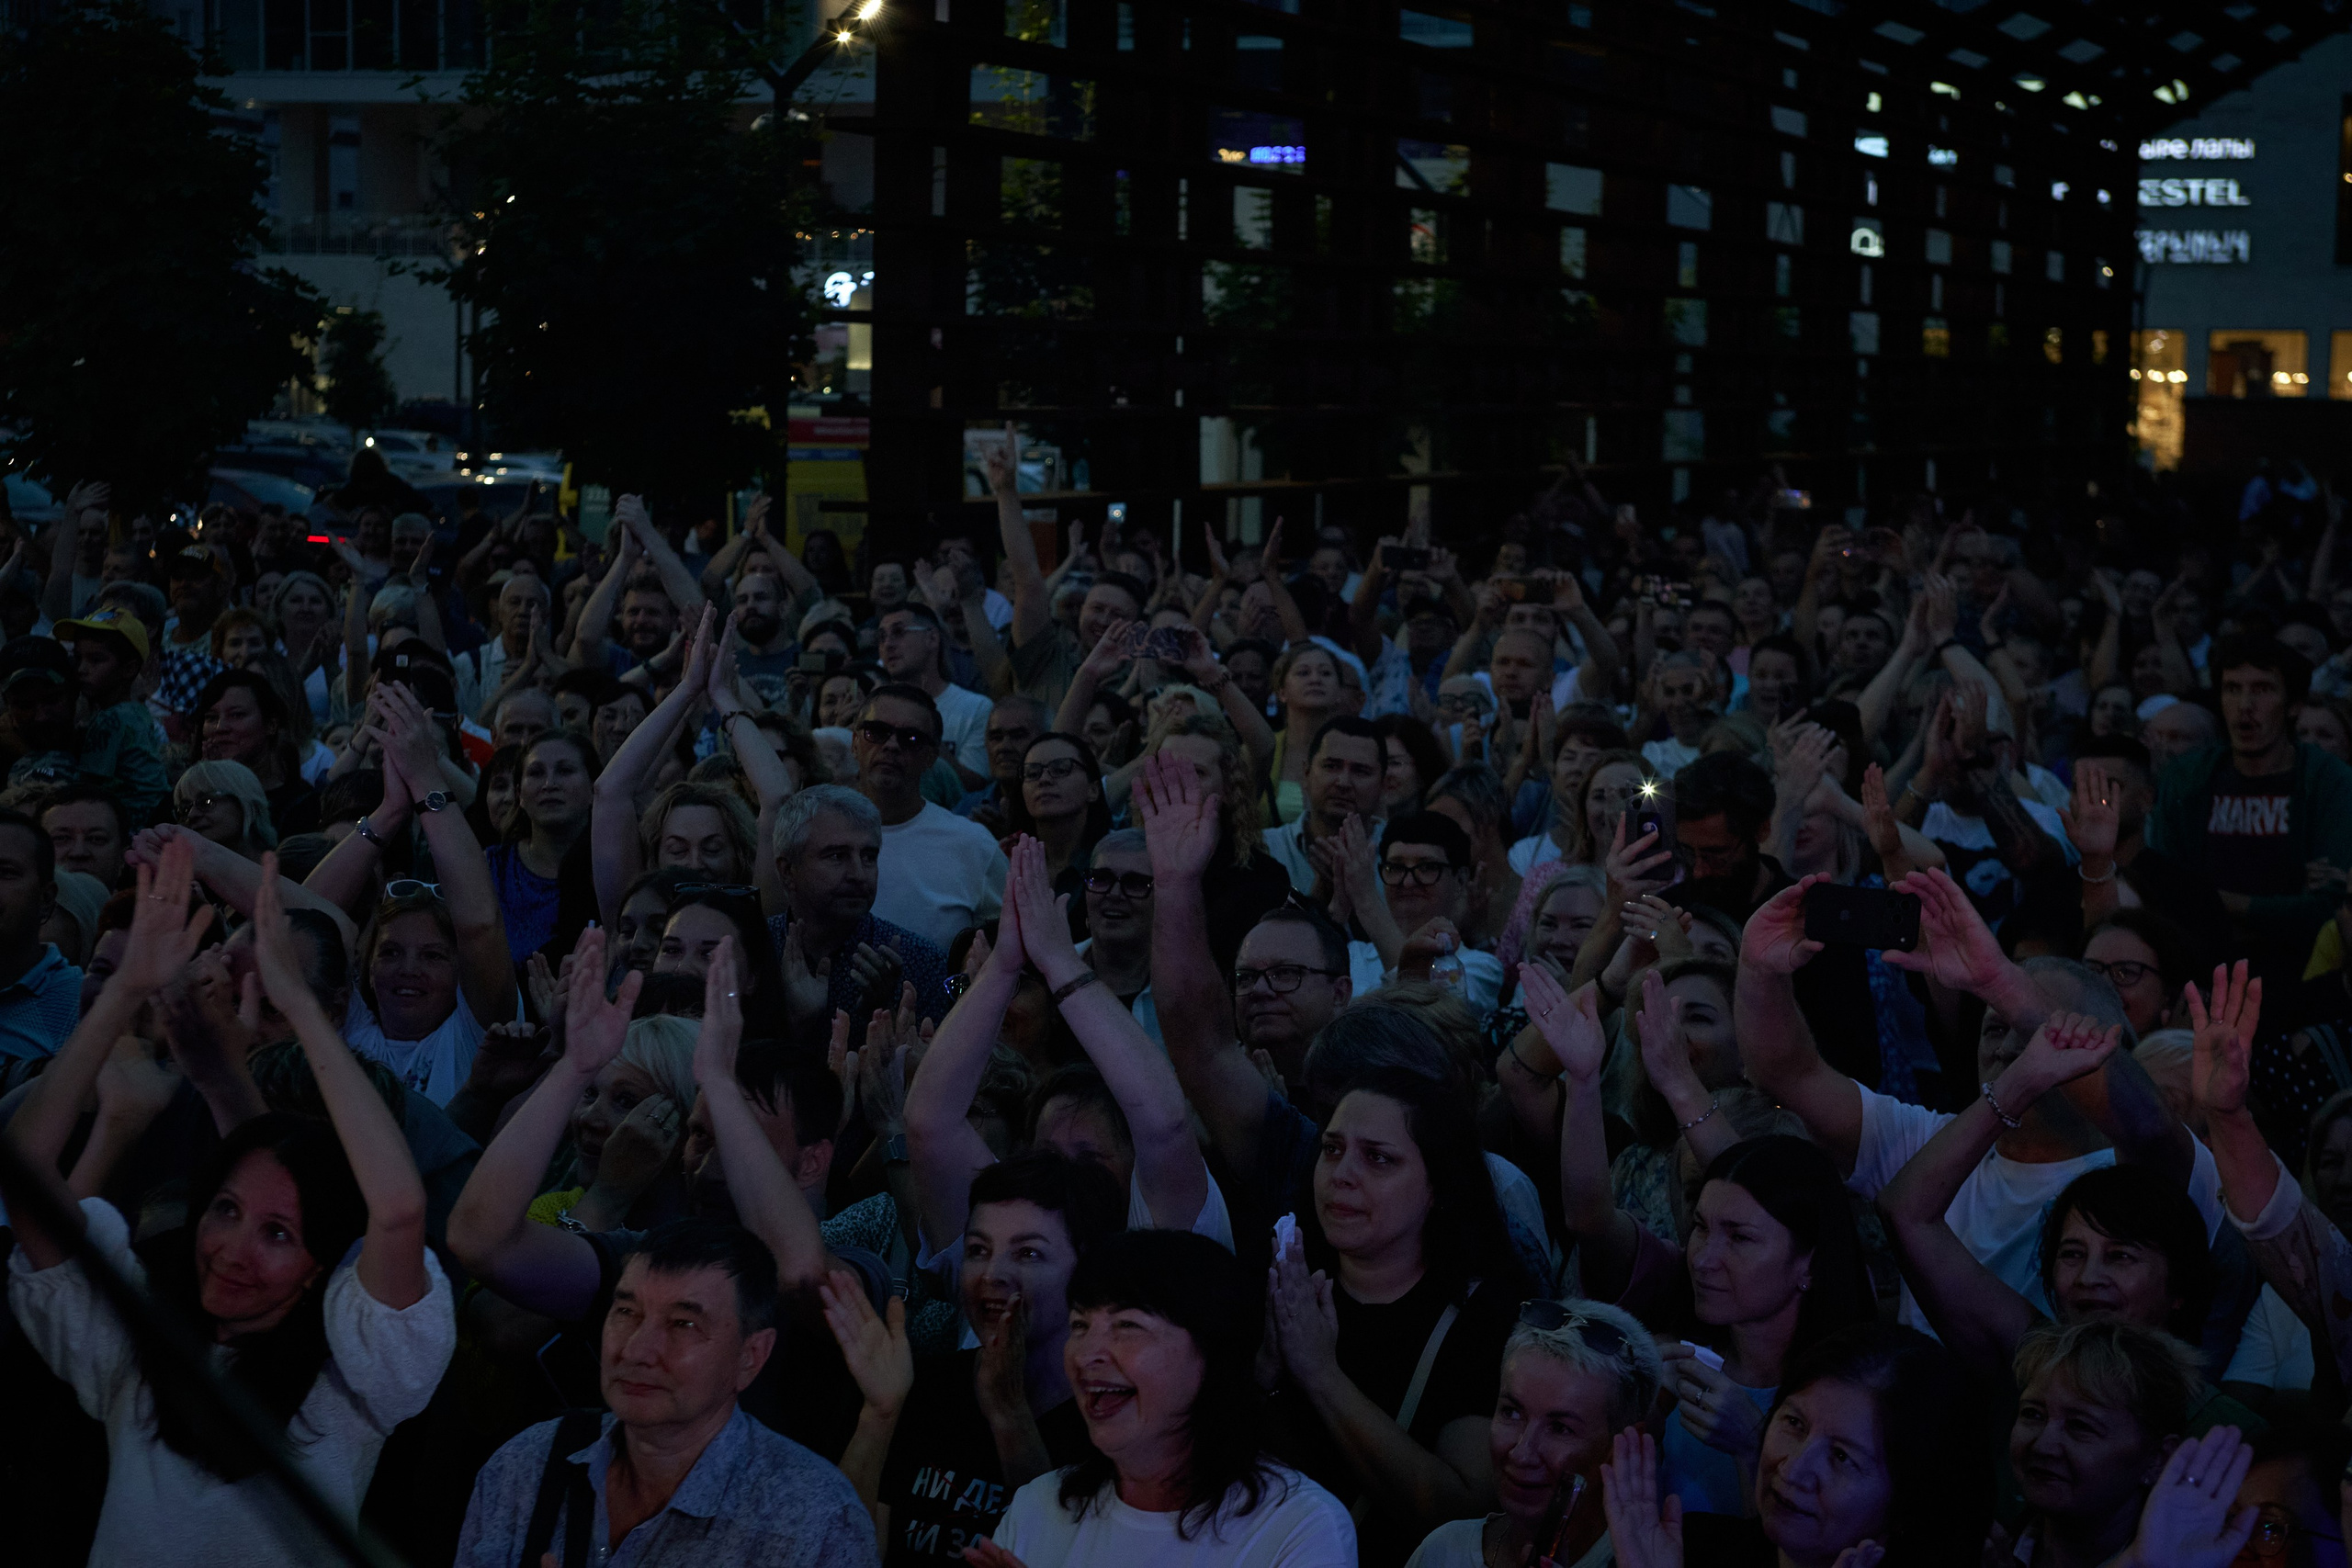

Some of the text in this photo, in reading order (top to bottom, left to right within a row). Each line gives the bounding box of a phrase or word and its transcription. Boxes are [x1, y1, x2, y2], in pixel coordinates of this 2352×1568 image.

[2189, 138, 2256, 160] лапы
[2137, 178, 2251, 207] ESTEL
[911, 1464, 1011, 1518] НИ ДЕ
